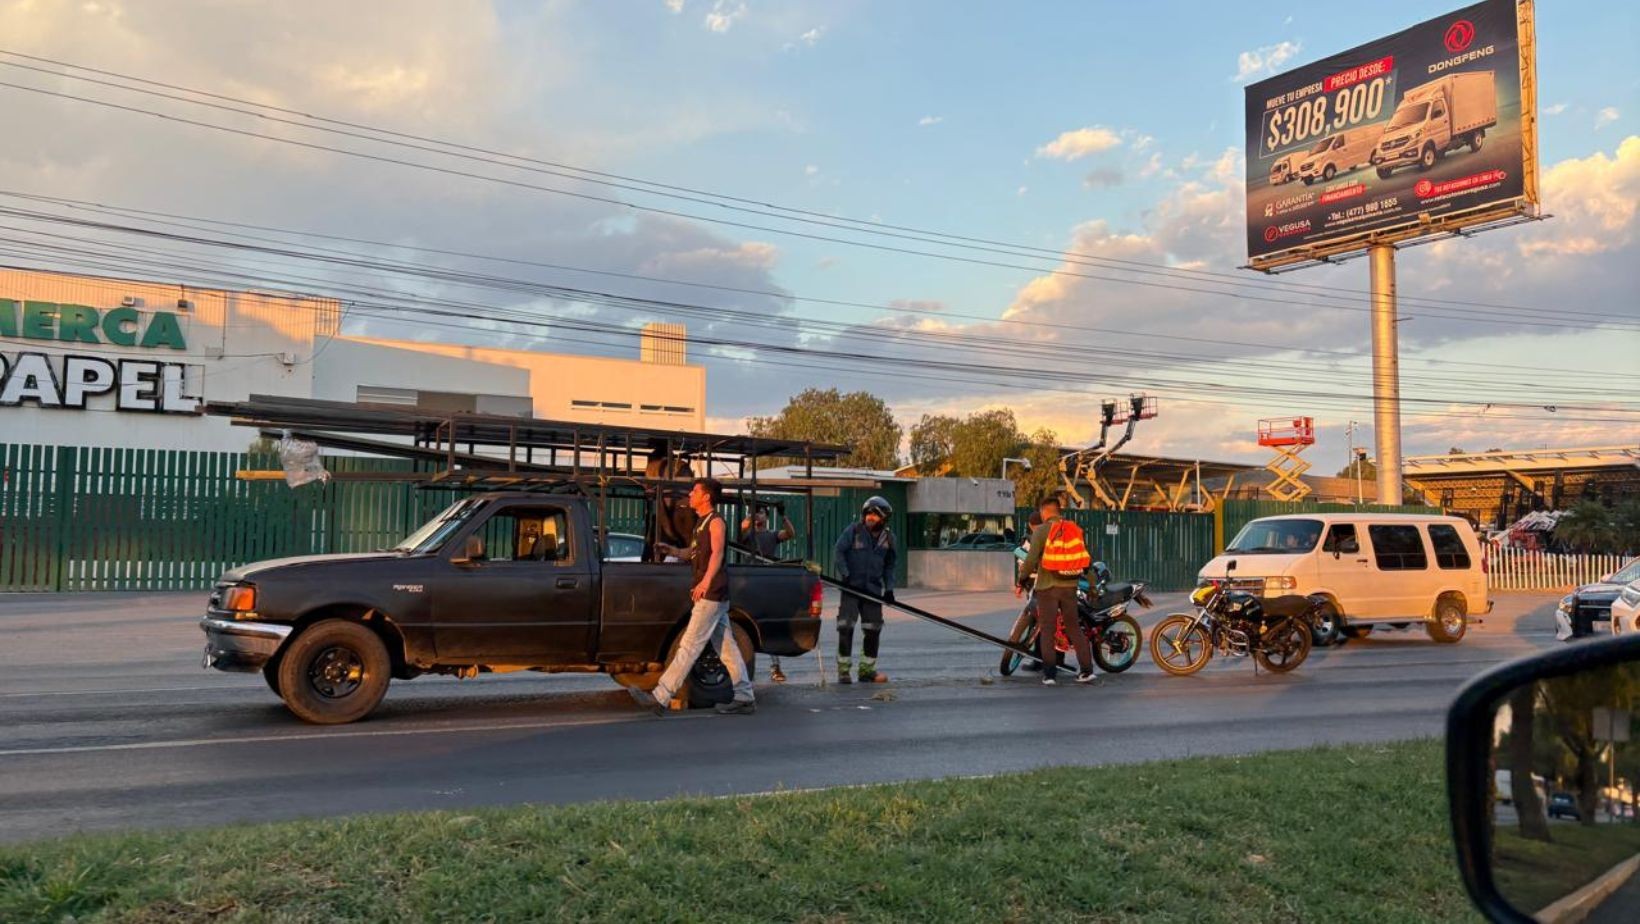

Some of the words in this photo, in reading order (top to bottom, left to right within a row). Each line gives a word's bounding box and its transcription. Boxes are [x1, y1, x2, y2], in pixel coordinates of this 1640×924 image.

[1428, 45, 1495, 74] DONGFENG
[1330, 70, 1358, 89] PRECIO
[1287, 91, 1295, 103] TU
[1295, 82, 1323, 100] EMPRESA
[1279, 219, 1312, 233] VEGUSA
[0, 351, 204, 417] APEL
